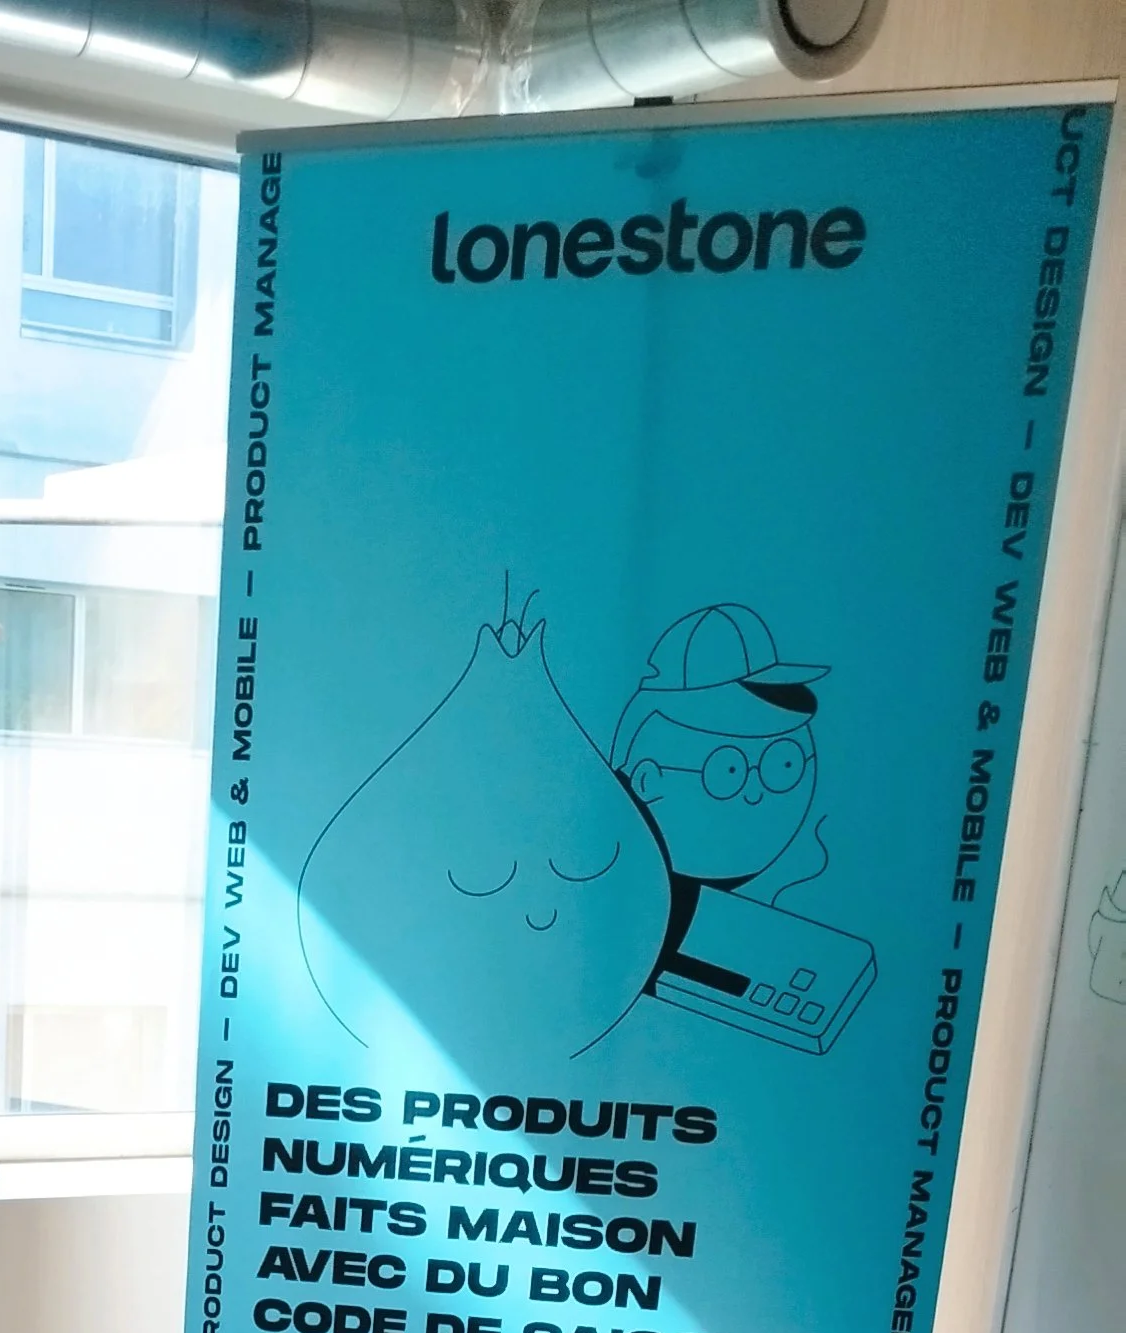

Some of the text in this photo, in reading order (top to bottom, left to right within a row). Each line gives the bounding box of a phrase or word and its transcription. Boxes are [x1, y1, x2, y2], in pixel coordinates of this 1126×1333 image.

[432, 198, 866, 283] lonestone
[1023, 226, 1070, 396] DESIGN
[243, 354, 271, 550] PRODUCT
[1002, 472, 1034, 560] DEV
[984, 580, 1018, 683] WEB
[233, 618, 258, 760] MOBILE
[977, 700, 1000, 731] &
[231, 777, 248, 805] &
[953, 750, 994, 901] MOBILE
[225, 821, 247, 908] WEB
[220, 926, 240, 998] DEV
[918, 969, 962, 1156] PRODUCT
[211, 1060, 233, 1187] DESIGN
[266, 1082, 717, 1144] DES PRODUITS
[261, 1134, 659, 1195] NUMÉRIQUES
[259, 1192, 697, 1258] FAITS MAISON
[257, 1246, 661, 1310] AVEC DU BON
